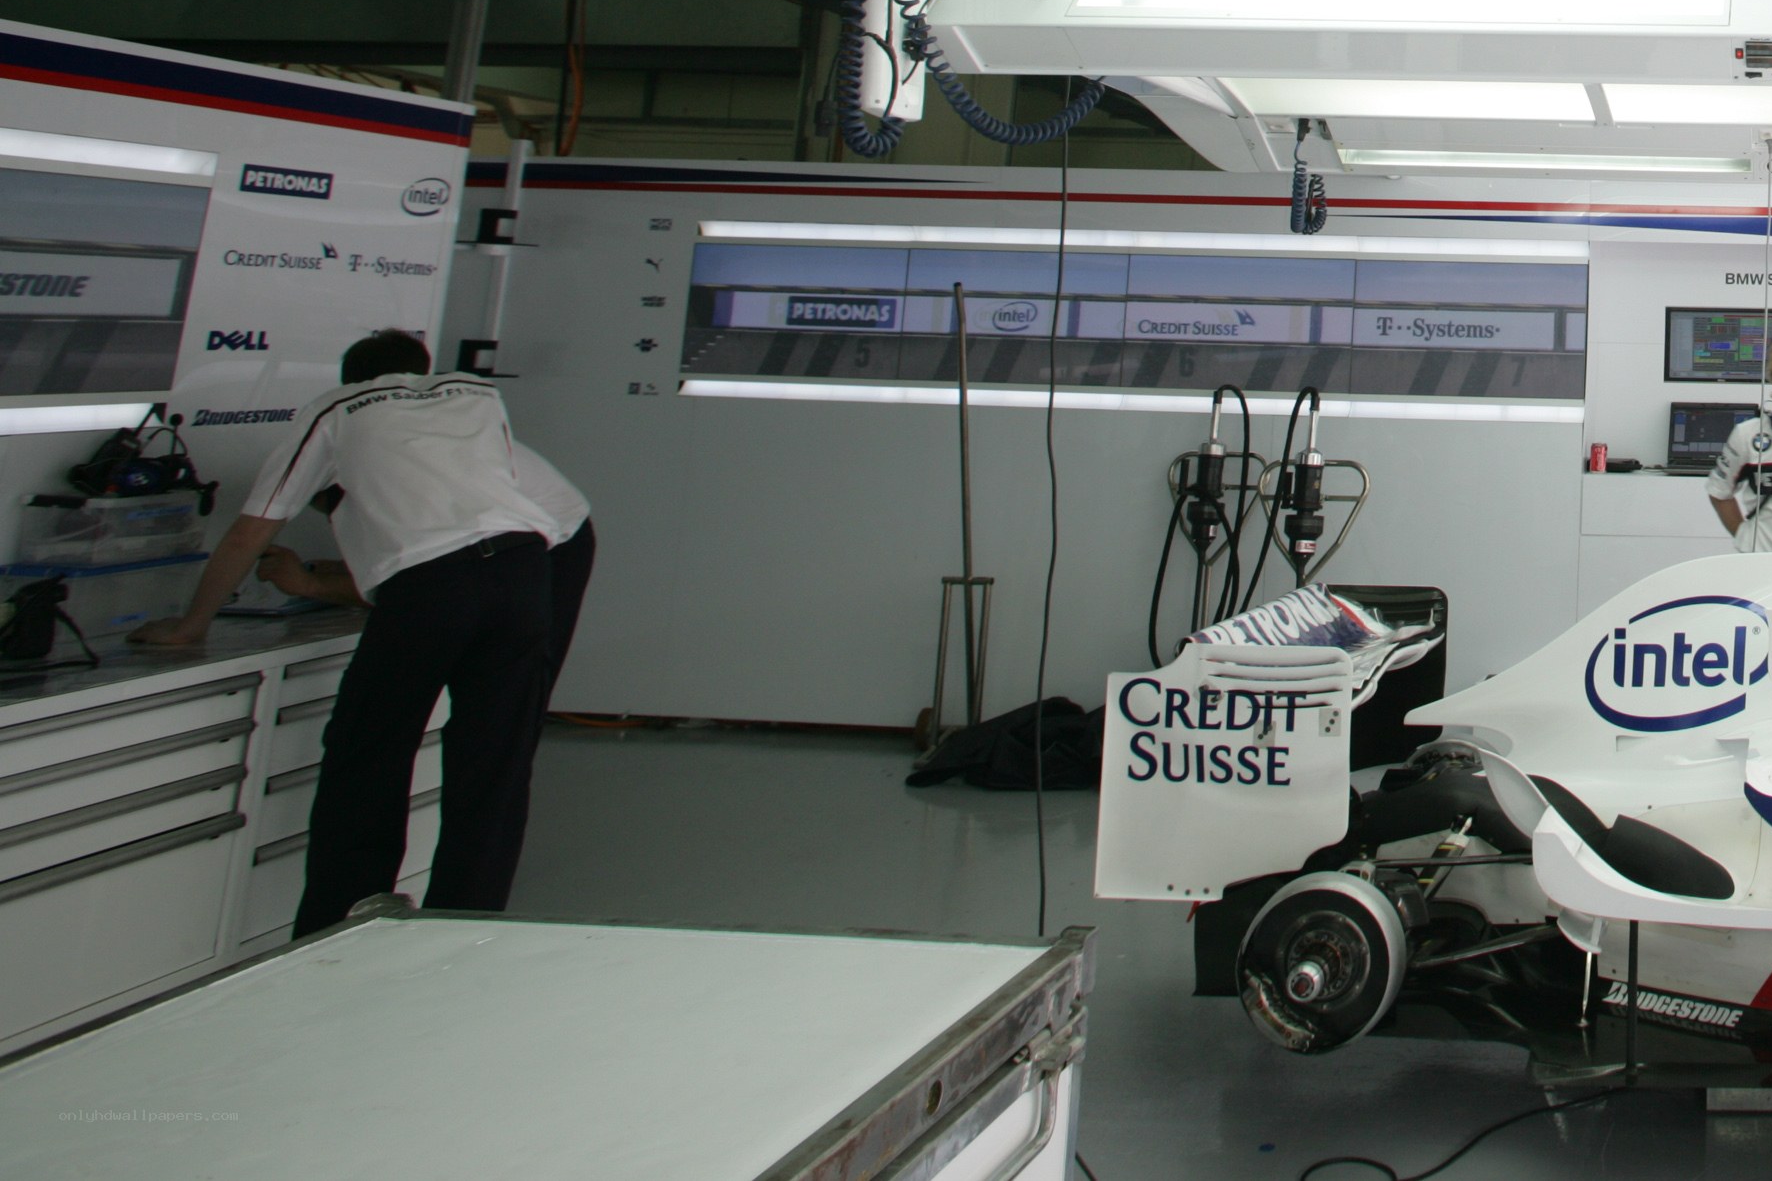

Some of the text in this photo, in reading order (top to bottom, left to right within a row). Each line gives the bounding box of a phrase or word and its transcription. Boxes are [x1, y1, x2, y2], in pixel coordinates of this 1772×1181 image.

[244, 169, 329, 194] PETRONAS
[223, 249, 323, 270] CREDIT SUISSE
[0, 272, 91, 298] STONE
[1725, 272, 1764, 285] BMW
[791, 302, 890, 323] PETRONAS
[1137, 318, 1239, 337] CREDIT SUISSE
[206, 330, 270, 351] DELL
[854, 338, 871, 368] 5
[345, 392, 388, 415] BMW
[391, 390, 443, 401] Sauber
[191, 408, 298, 428] BRIDGESTONE
[1118, 677, 1308, 732] CREDIT
[1127, 731, 1291, 787] SUISSE
